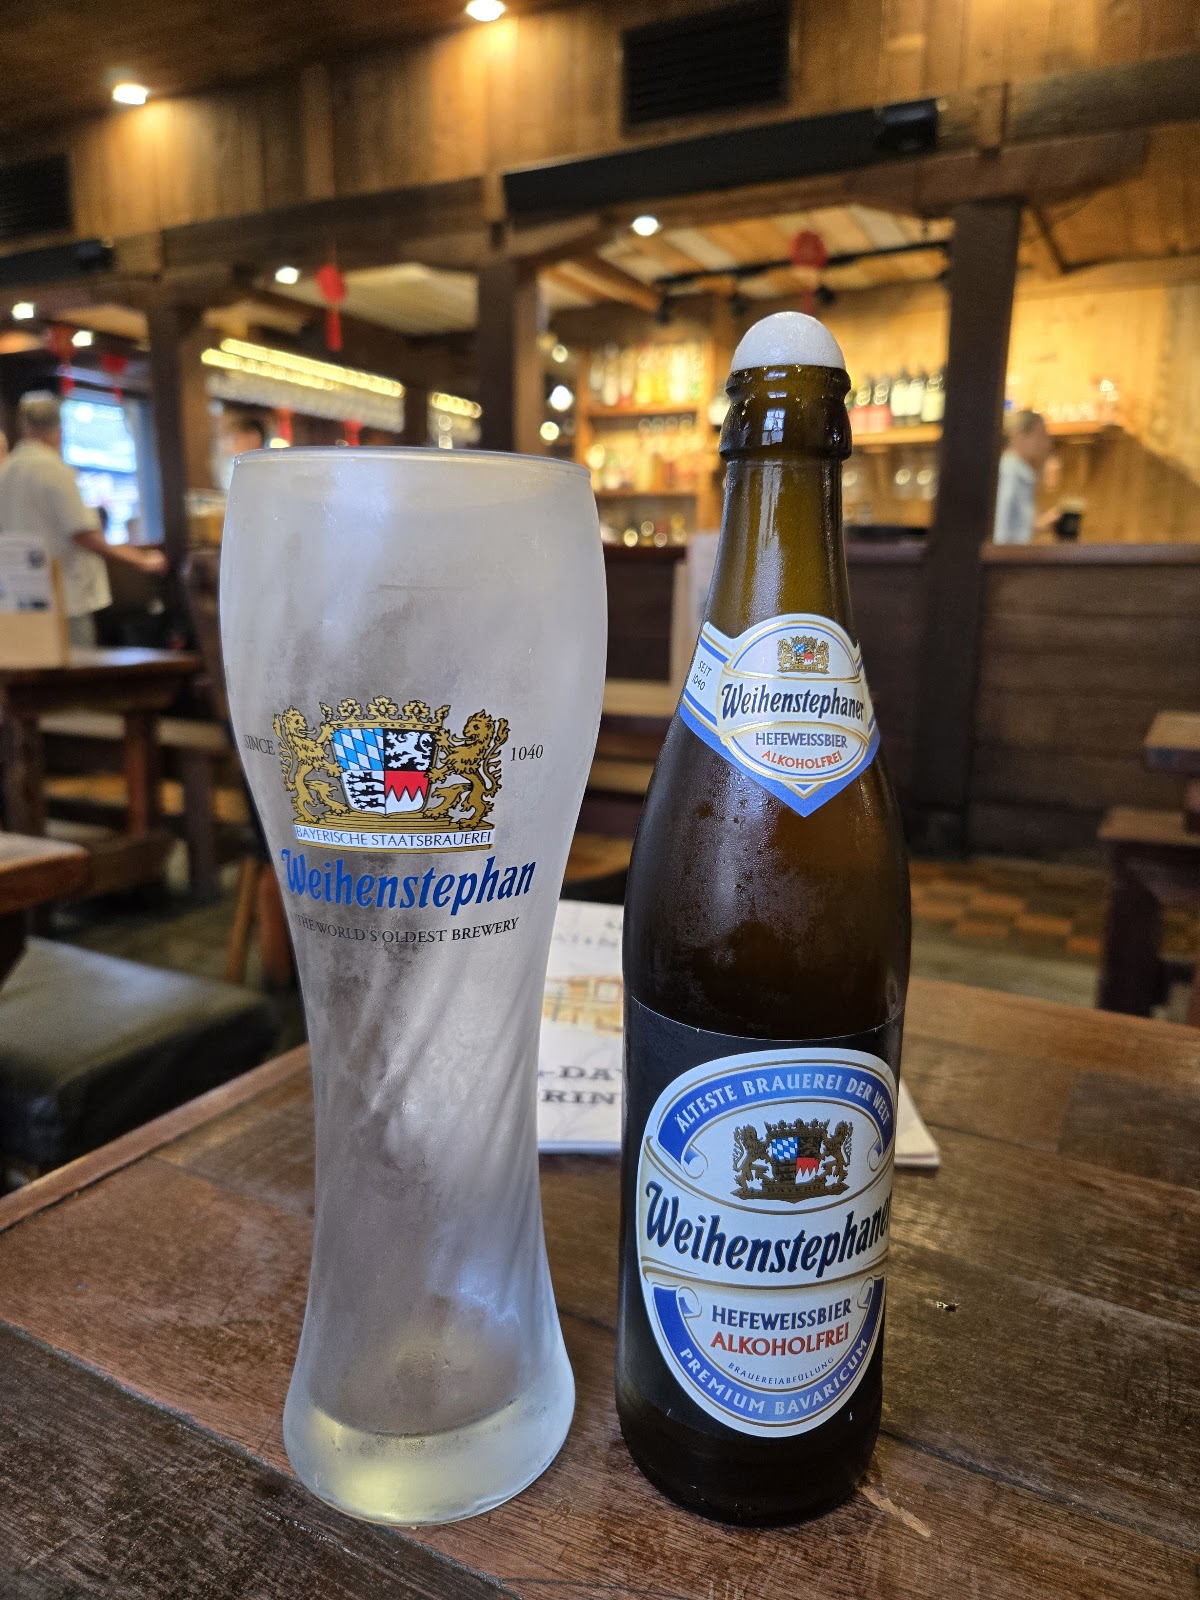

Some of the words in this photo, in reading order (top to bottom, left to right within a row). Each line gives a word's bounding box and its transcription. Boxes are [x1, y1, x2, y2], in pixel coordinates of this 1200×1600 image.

[697, 660, 713, 677] SEIT
[721, 683, 865, 722] Weihenstephaner
[243, 734, 276, 756] SINCE
[510, 744, 544, 762] 1040
[755, 732, 849, 749] HEFEWEISSBIER
[761, 749, 843, 770] ALKOHOLFREI
[296, 826, 368, 846] BAYERISCHE
[371, 831, 491, 848] STAATSBRAUEREI
[281, 849, 537, 916] Weihenstephan
[296, 913, 316, 932] THE
[316, 921, 378, 942] WORLD'S
[381, 930, 447, 944] OLDEST
[451, 917, 519, 942] BREWERY
[674, 1084, 738, 1134] ÄLTESTE
[742, 1073, 842, 1097] BRAUEREI
[846, 1078, 873, 1102] DER
[872, 1090, 890, 1126] WELT
[645, 1180, 892, 1279] Weihenstephaner
[711, 1297, 852, 1331] HEFEWEISSBIER
[710, 1322, 849, 1357] ALKOHOLFREI
[680, 1347, 765, 1415] PREMIUM
[775, 1338, 868, 1416] BAVARICUM
[728, 1357, 834, 1385] BRAUEREIABFÜLLUNG
